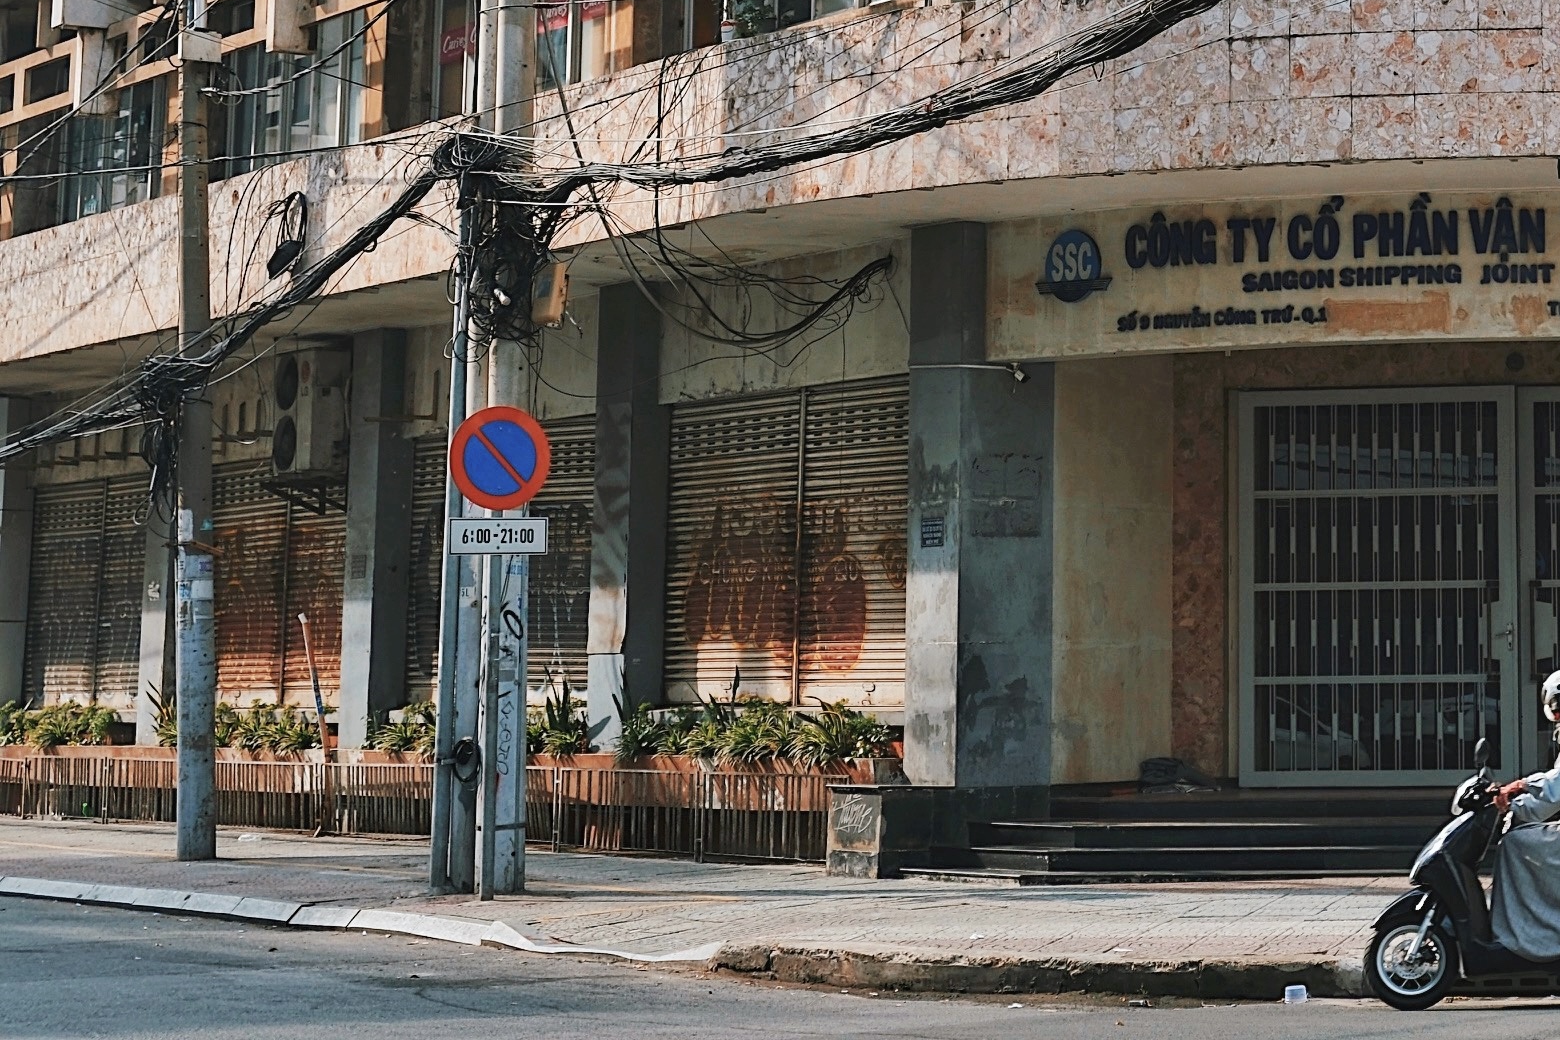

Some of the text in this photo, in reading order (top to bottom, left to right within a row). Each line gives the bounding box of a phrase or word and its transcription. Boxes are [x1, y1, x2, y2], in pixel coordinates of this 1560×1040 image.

[1125, 212, 1217, 269] CÔNG
[1226, 217, 1276, 263] TY
[1288, 195, 1345, 261] CỔ
[1353, 192, 1459, 259] PHẦN
[1469, 197, 1546, 263] VẬN
[1051, 244, 1092, 282] SSC
[1242, 268, 1335, 293] SAIGON
[1339, 264, 1462, 287] SHIPPING
[1480, 263, 1554, 285] JOINT
[1117, 311, 1138, 332] SỐ
[1139, 315, 1150, 330] 9
[1153, 306, 1211, 329] NGUYỄN
[1213, 307, 1257, 326] CÔNG
